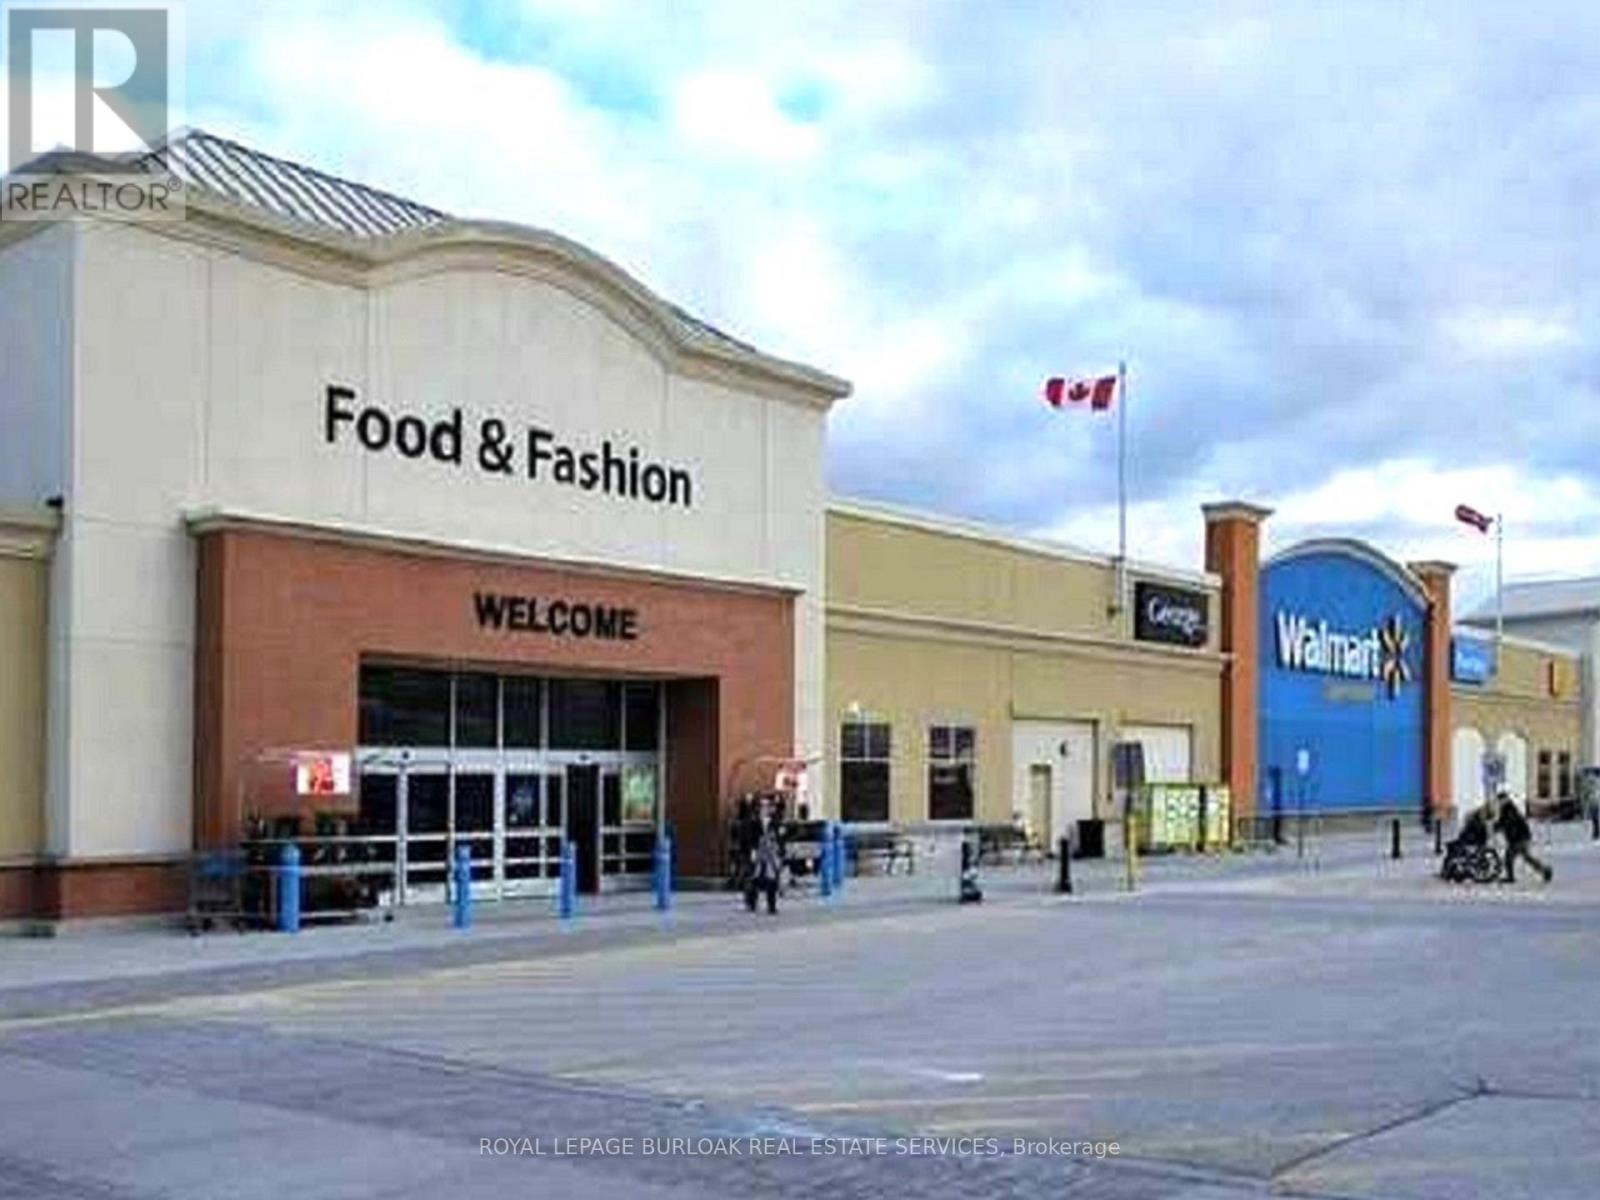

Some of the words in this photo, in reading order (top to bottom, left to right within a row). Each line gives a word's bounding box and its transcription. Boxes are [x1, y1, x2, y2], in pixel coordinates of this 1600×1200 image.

[325, 384, 463, 466] Food
[478, 418, 514, 475] &
[527, 428, 693, 506] Fashion
[474, 592, 639, 641] WELCOME
[1278, 609, 1380, 678] Walmart
